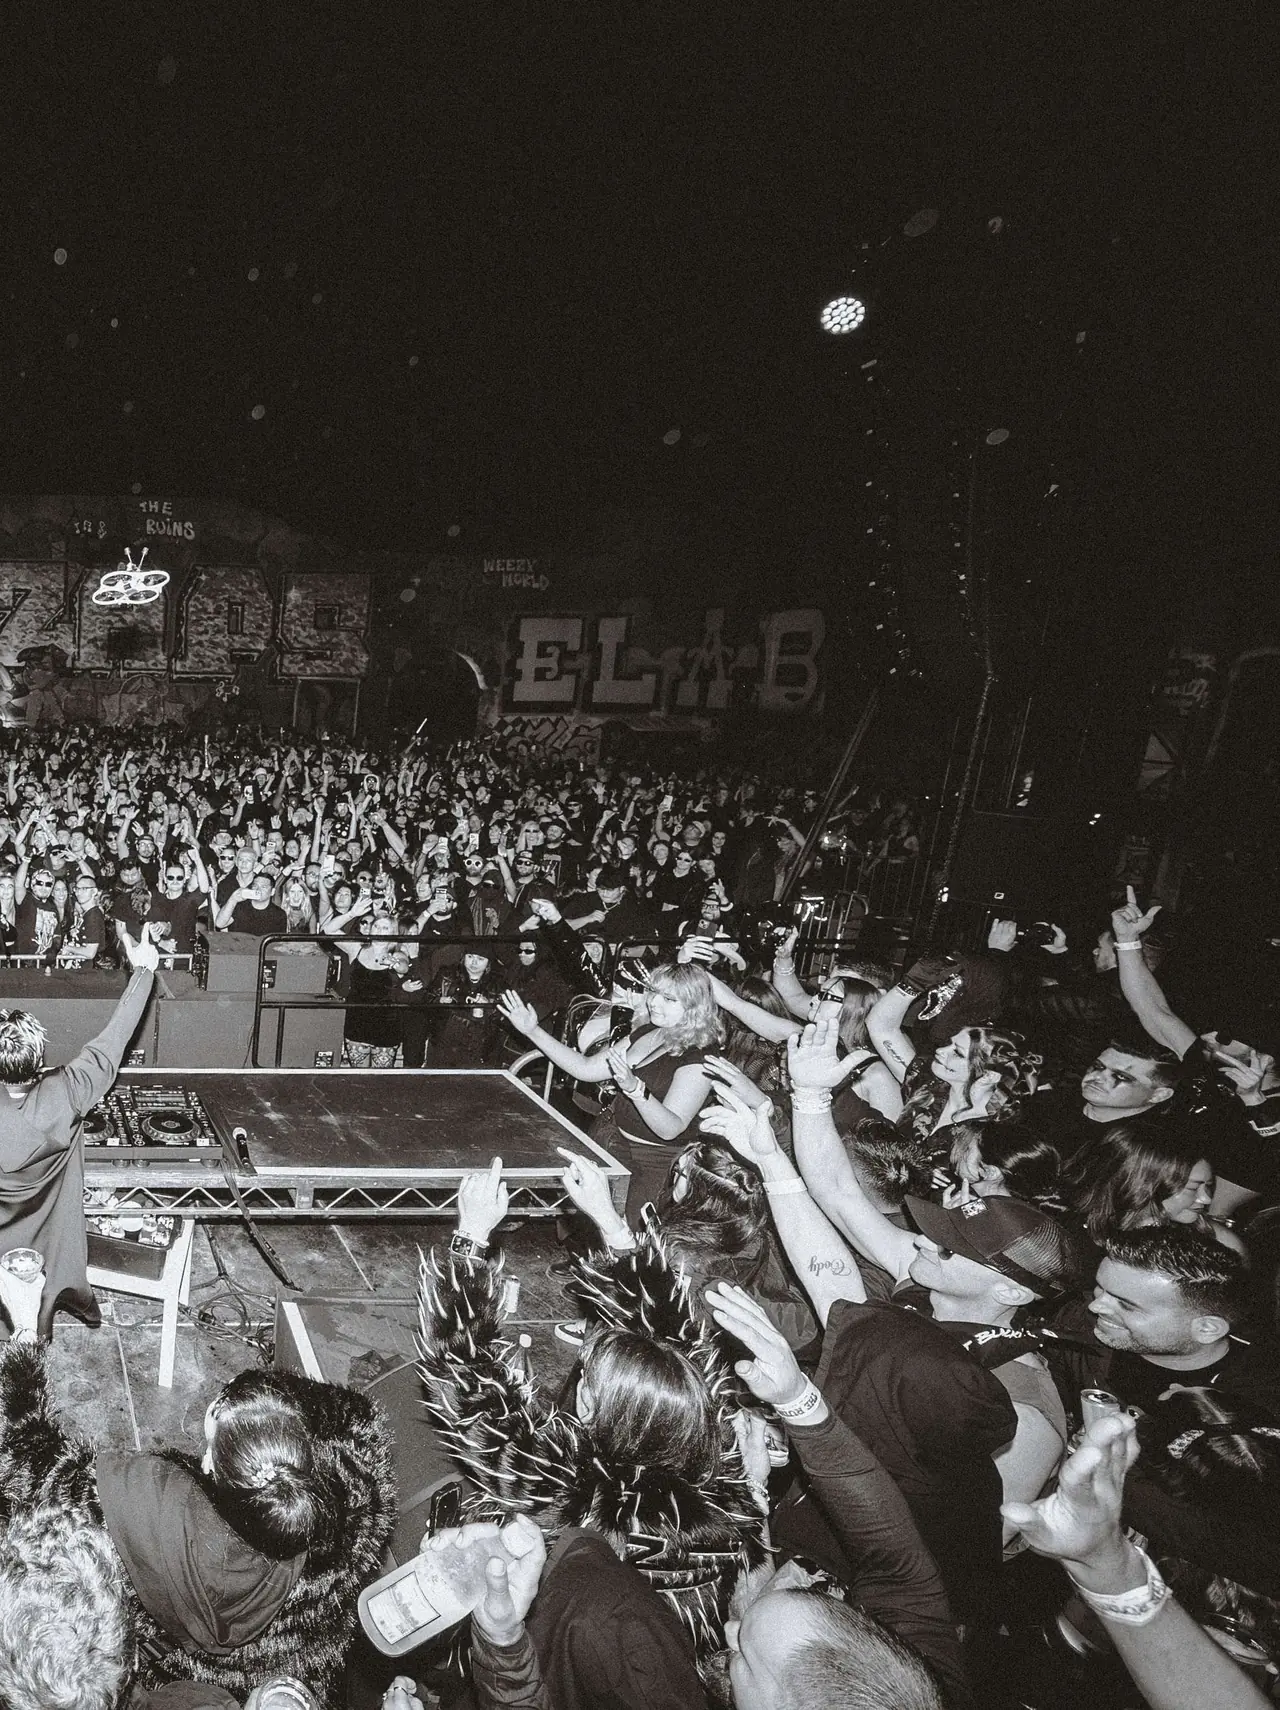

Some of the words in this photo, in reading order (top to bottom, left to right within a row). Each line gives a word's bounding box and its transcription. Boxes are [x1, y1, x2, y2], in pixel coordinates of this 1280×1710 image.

[140, 501, 172, 516] THE
[808, 1255, 852, 1277] Cody
[804, 1392, 818, 1410] THE
